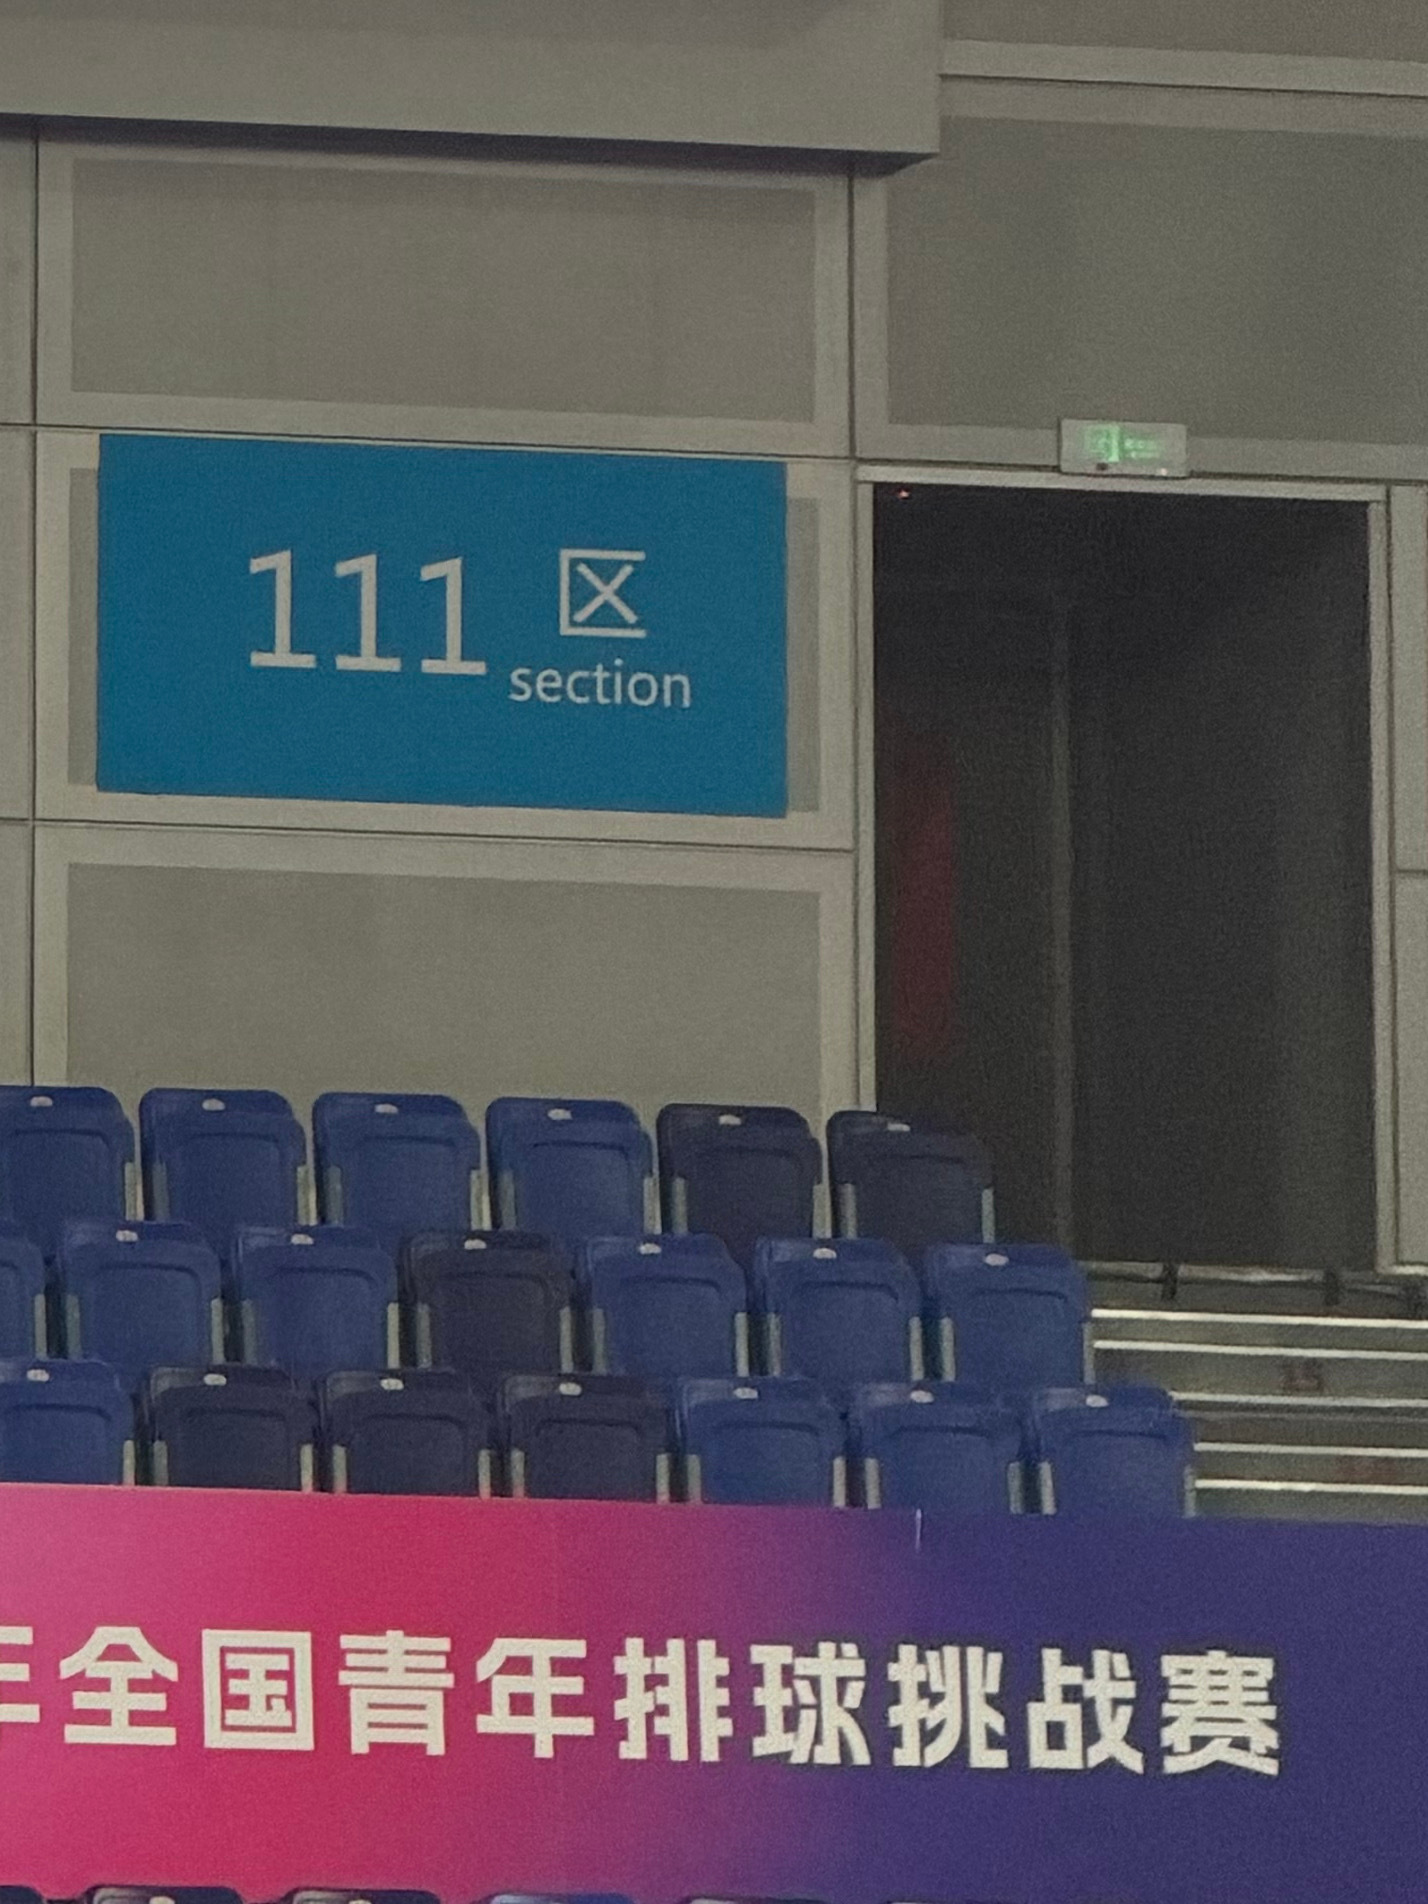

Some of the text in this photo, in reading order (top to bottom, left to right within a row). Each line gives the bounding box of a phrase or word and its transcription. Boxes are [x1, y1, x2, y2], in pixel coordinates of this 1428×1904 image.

[249, 549, 488, 676] 111
[558, 548, 647, 638] 区
[508, 658, 691, 708] section
